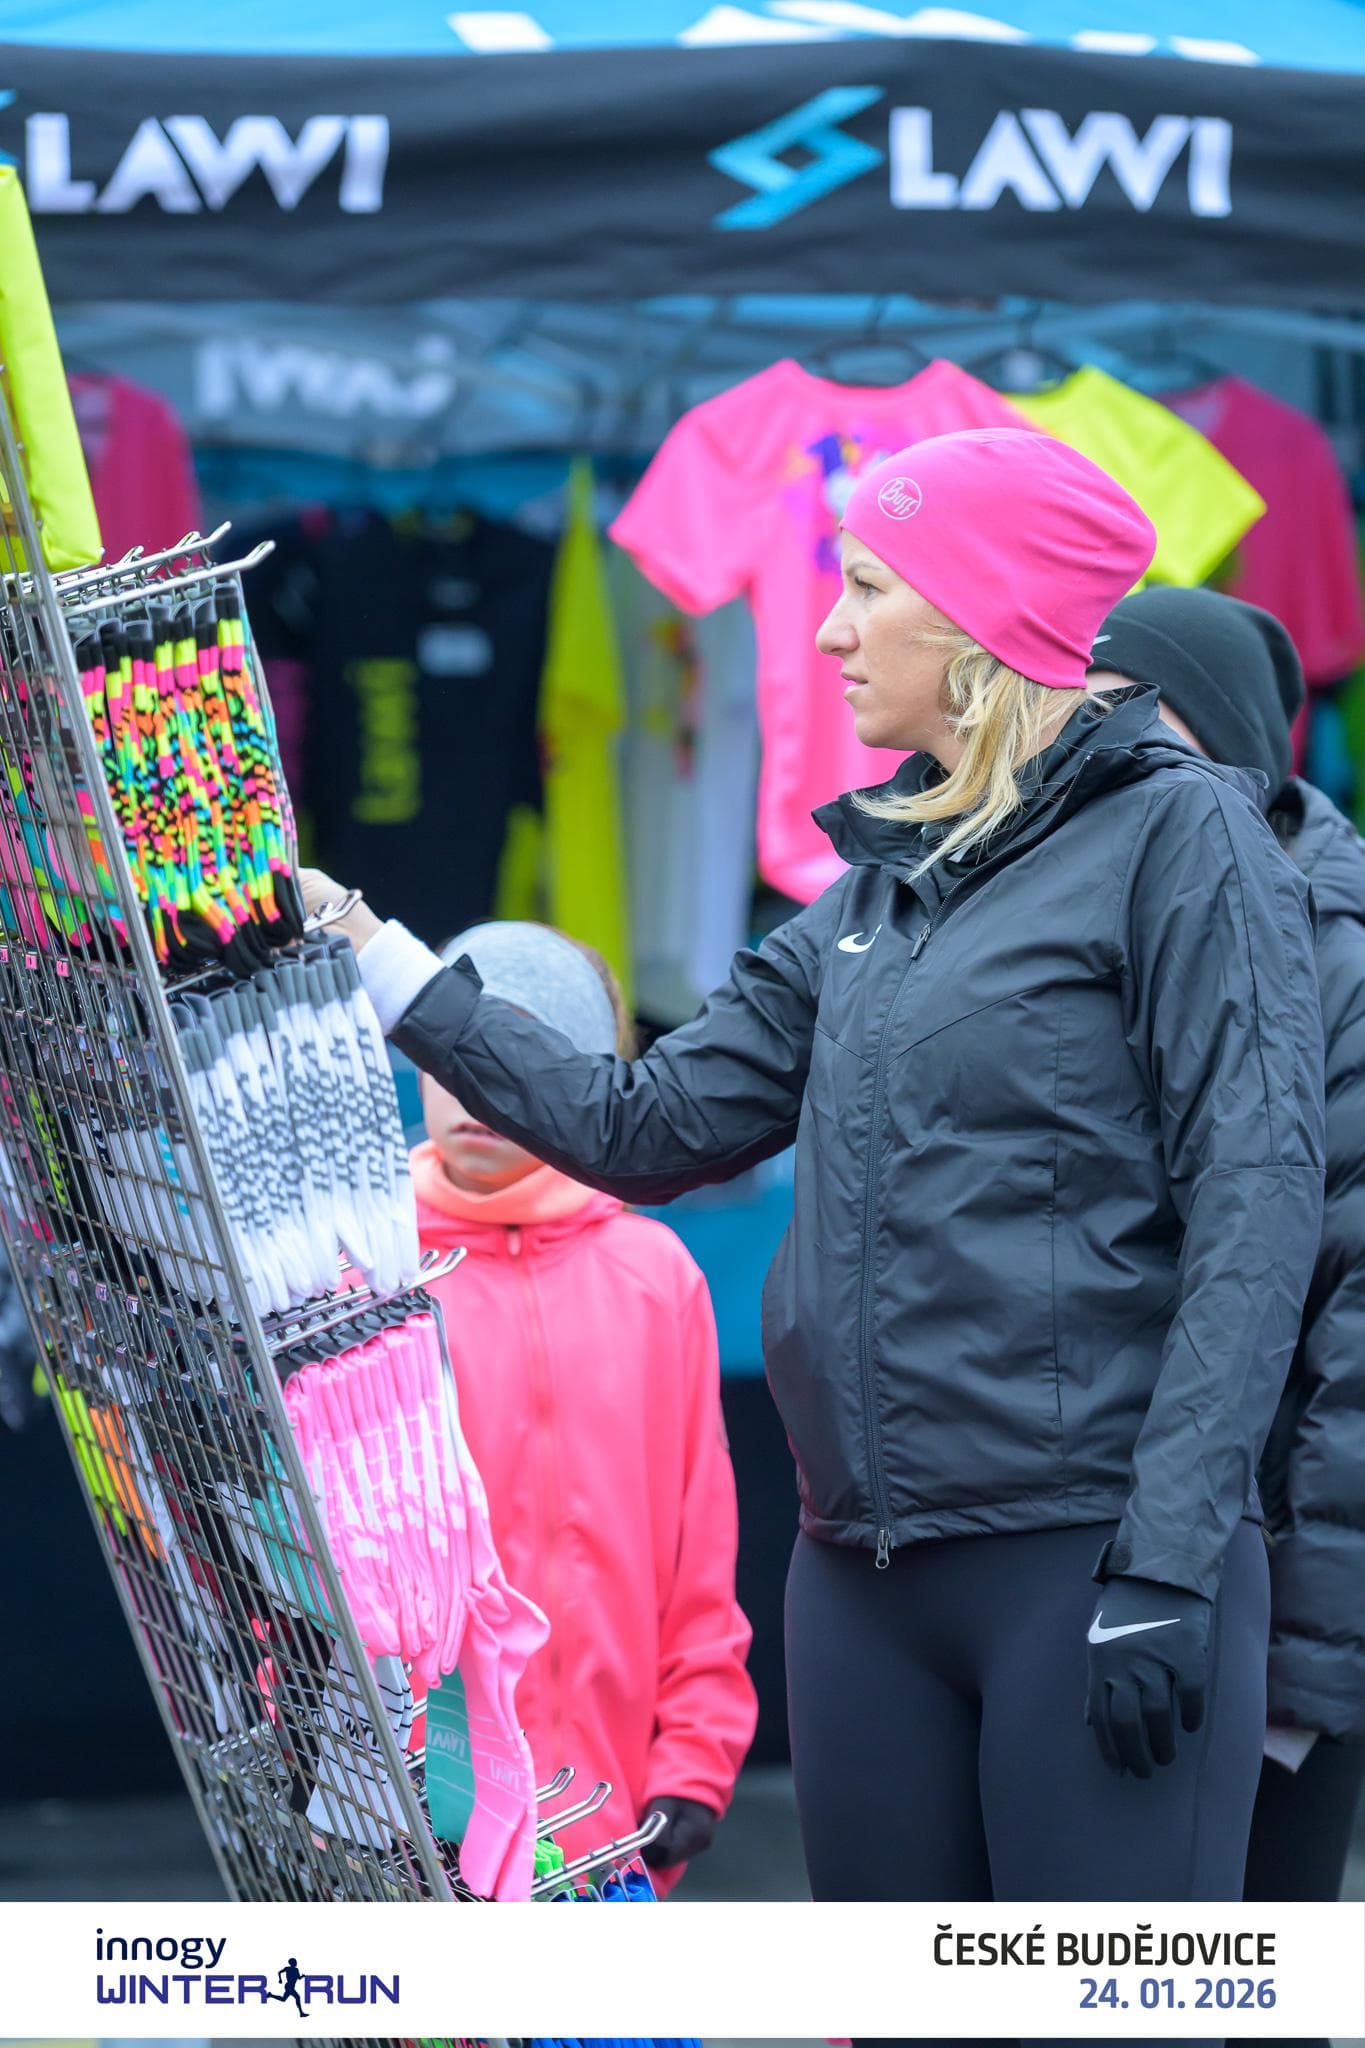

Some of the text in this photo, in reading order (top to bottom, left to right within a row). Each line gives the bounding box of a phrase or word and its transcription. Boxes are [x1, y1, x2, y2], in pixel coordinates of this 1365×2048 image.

[26, 112, 390, 213] LAWI
[889, 106, 1233, 218] LAWI
[881, 479, 920, 515] Buff
